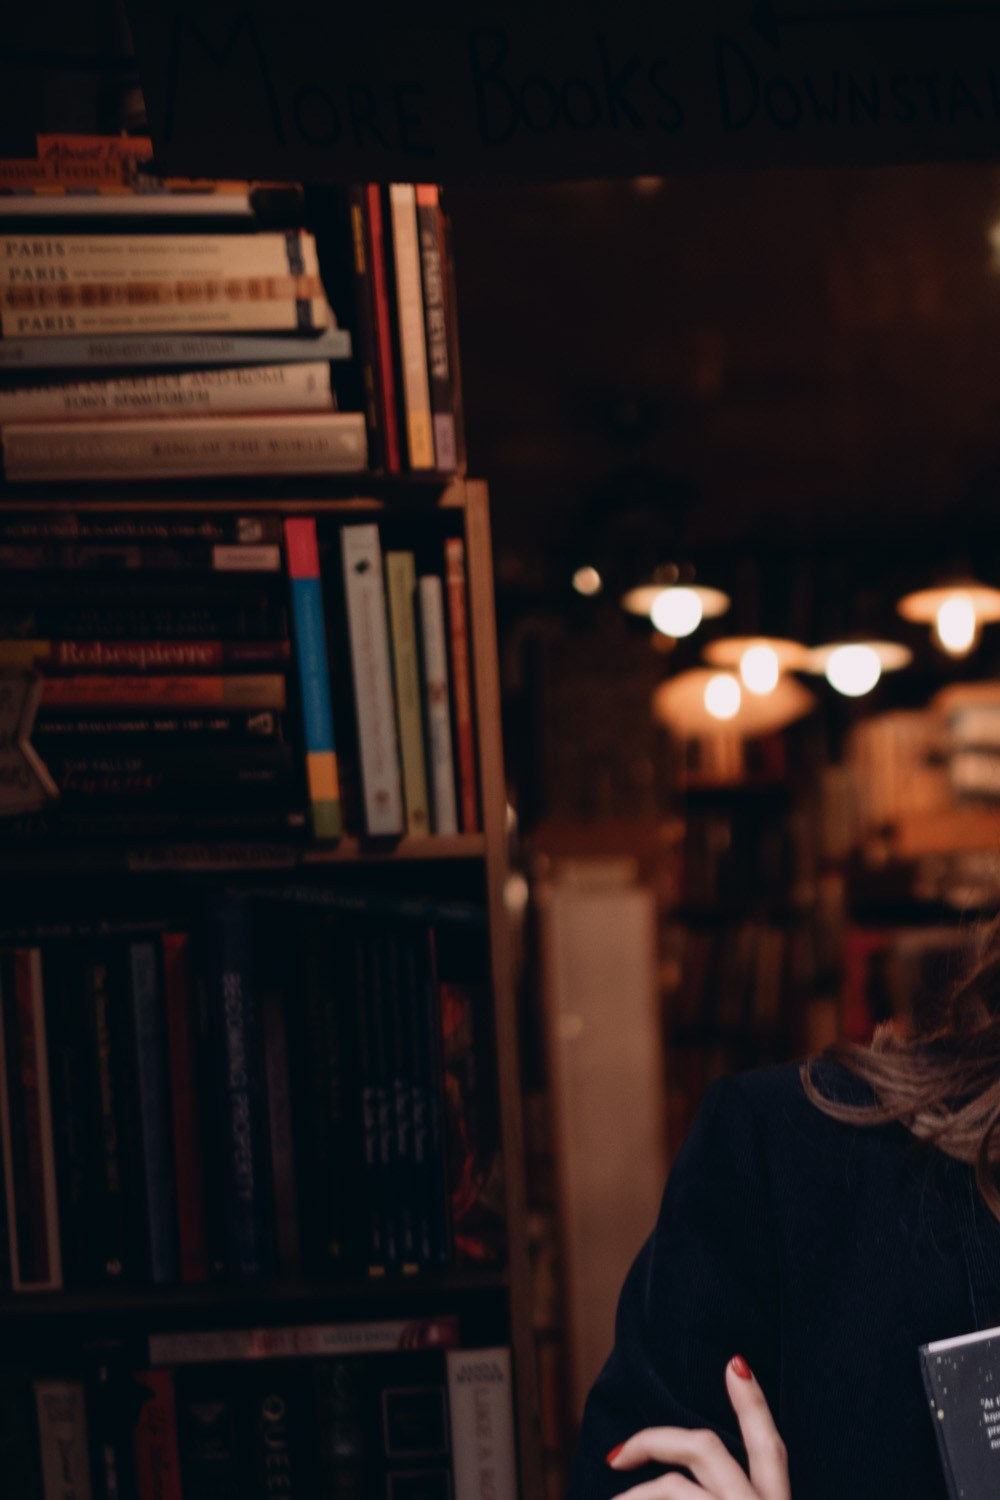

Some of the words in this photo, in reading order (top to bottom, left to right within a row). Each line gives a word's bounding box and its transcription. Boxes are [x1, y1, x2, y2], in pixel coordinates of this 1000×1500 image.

[165, 8, 436, 154] MORE
[467, 26, 686, 146] BOOKS
[6, 241, 65, 257] PARIS
[8, 266, 68, 282] PARIS
[18, 314, 76, 331] PARIS
[58, 638, 217, 671] Robespierre
